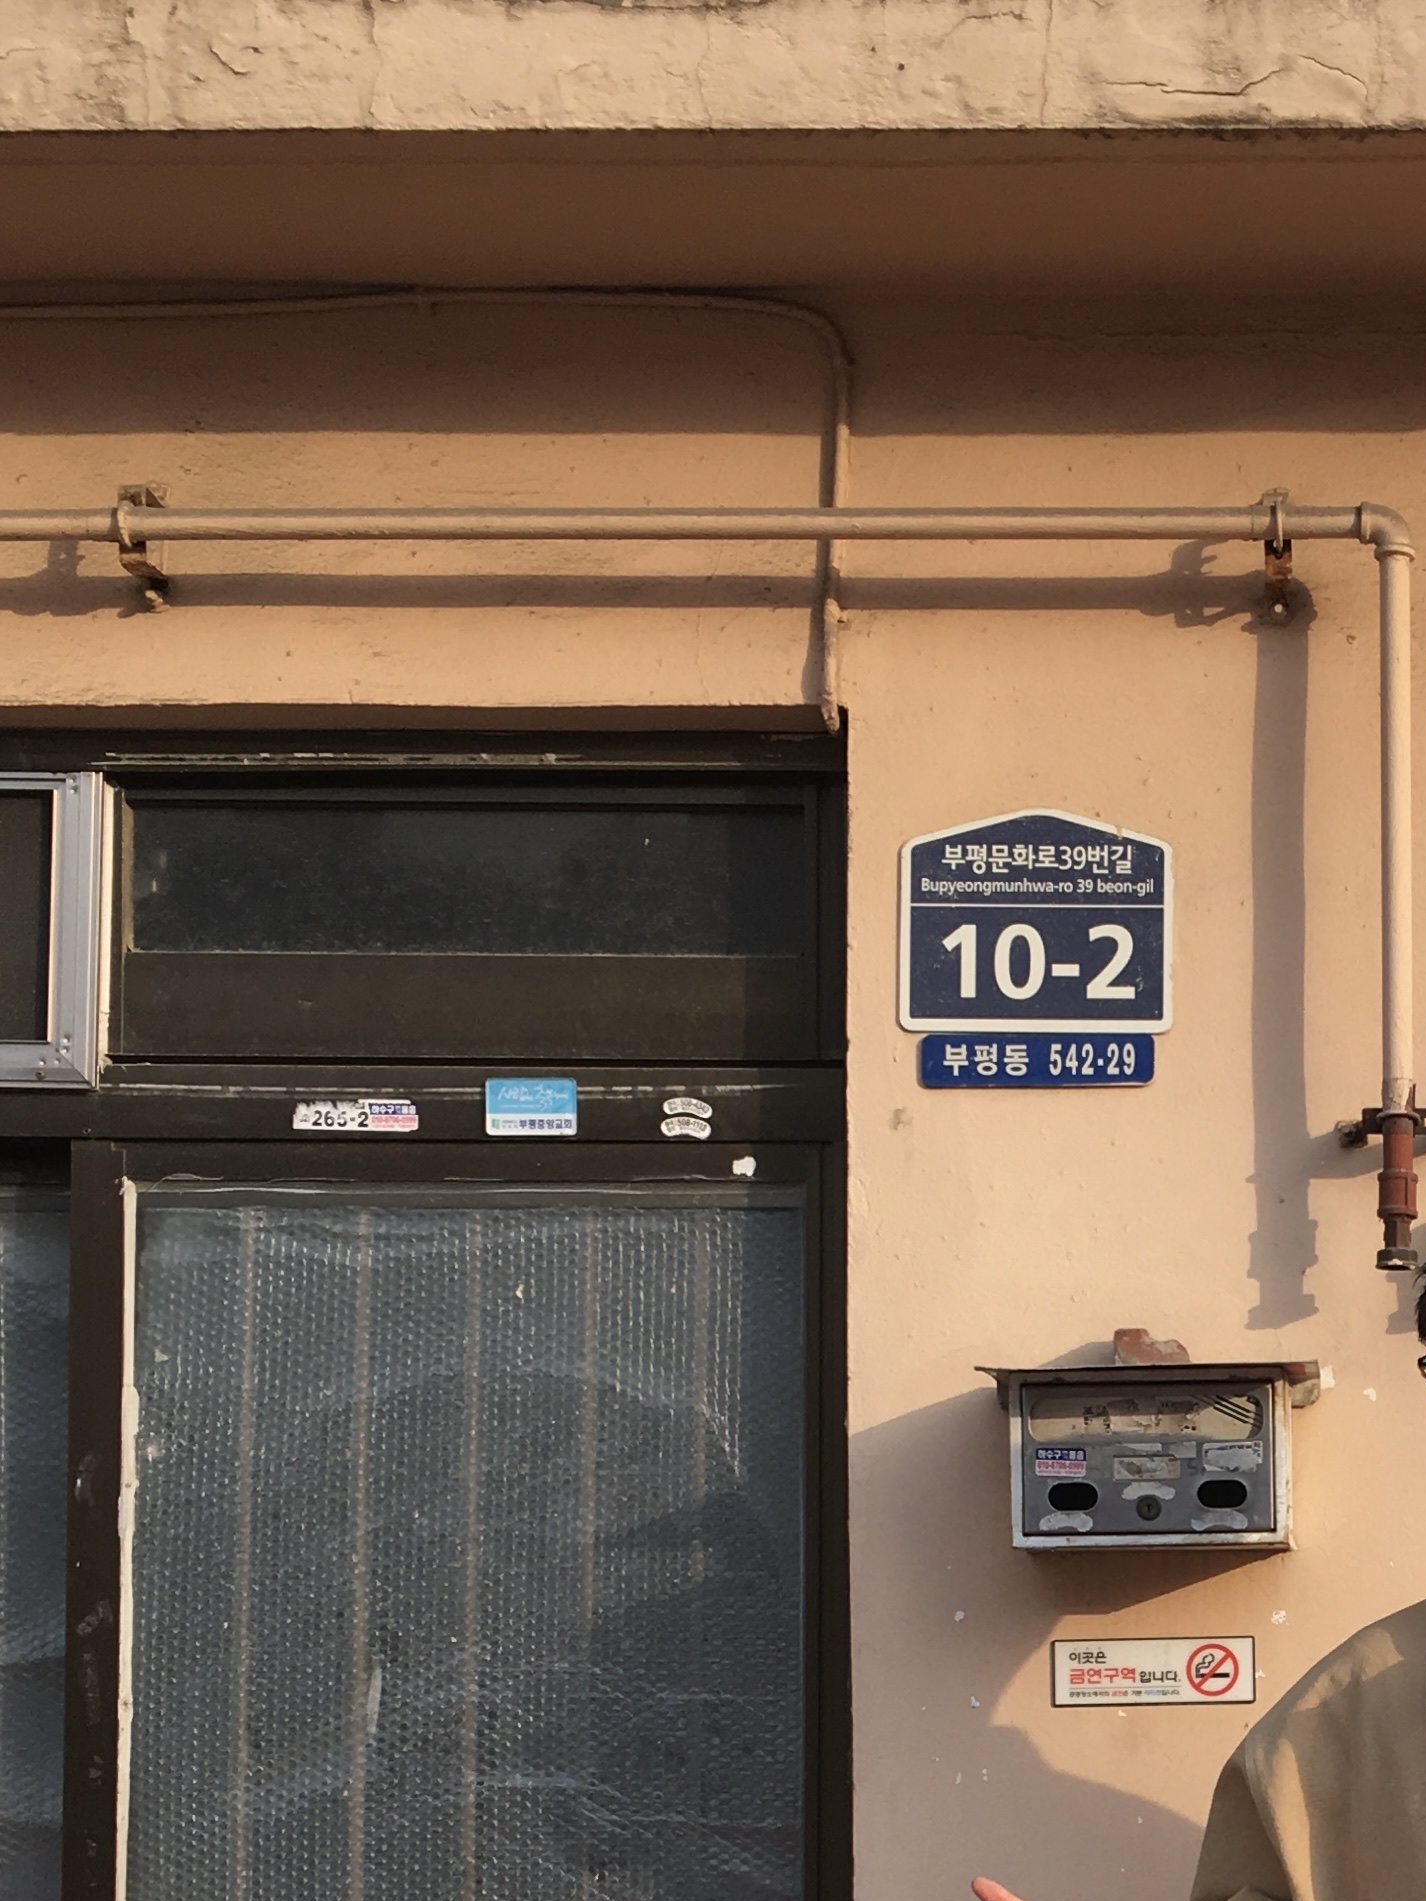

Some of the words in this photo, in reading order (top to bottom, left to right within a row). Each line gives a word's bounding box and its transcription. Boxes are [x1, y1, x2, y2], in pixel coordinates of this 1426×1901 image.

[942, 844, 1132, 874] 부평문화로39번길
[921, 878, 1073, 896] Bupyeongmunhwa-ro
[1077, 879, 1094, 893] 39
[1097, 878, 1154, 896] beon-gil
[942, 923, 1136, 1001] 10-2
[943, 1043, 1029, 1076] 부평동
[1049, 1043, 1136, 1076] 542-29
[312, 1110, 368, 1127] 265-2
[519, 1119, 572, 1129] 부평중앙교회
[1069, 1651, 1107, 1664] 이곳은
[1069, 1667, 1136, 1684] 금연구역
